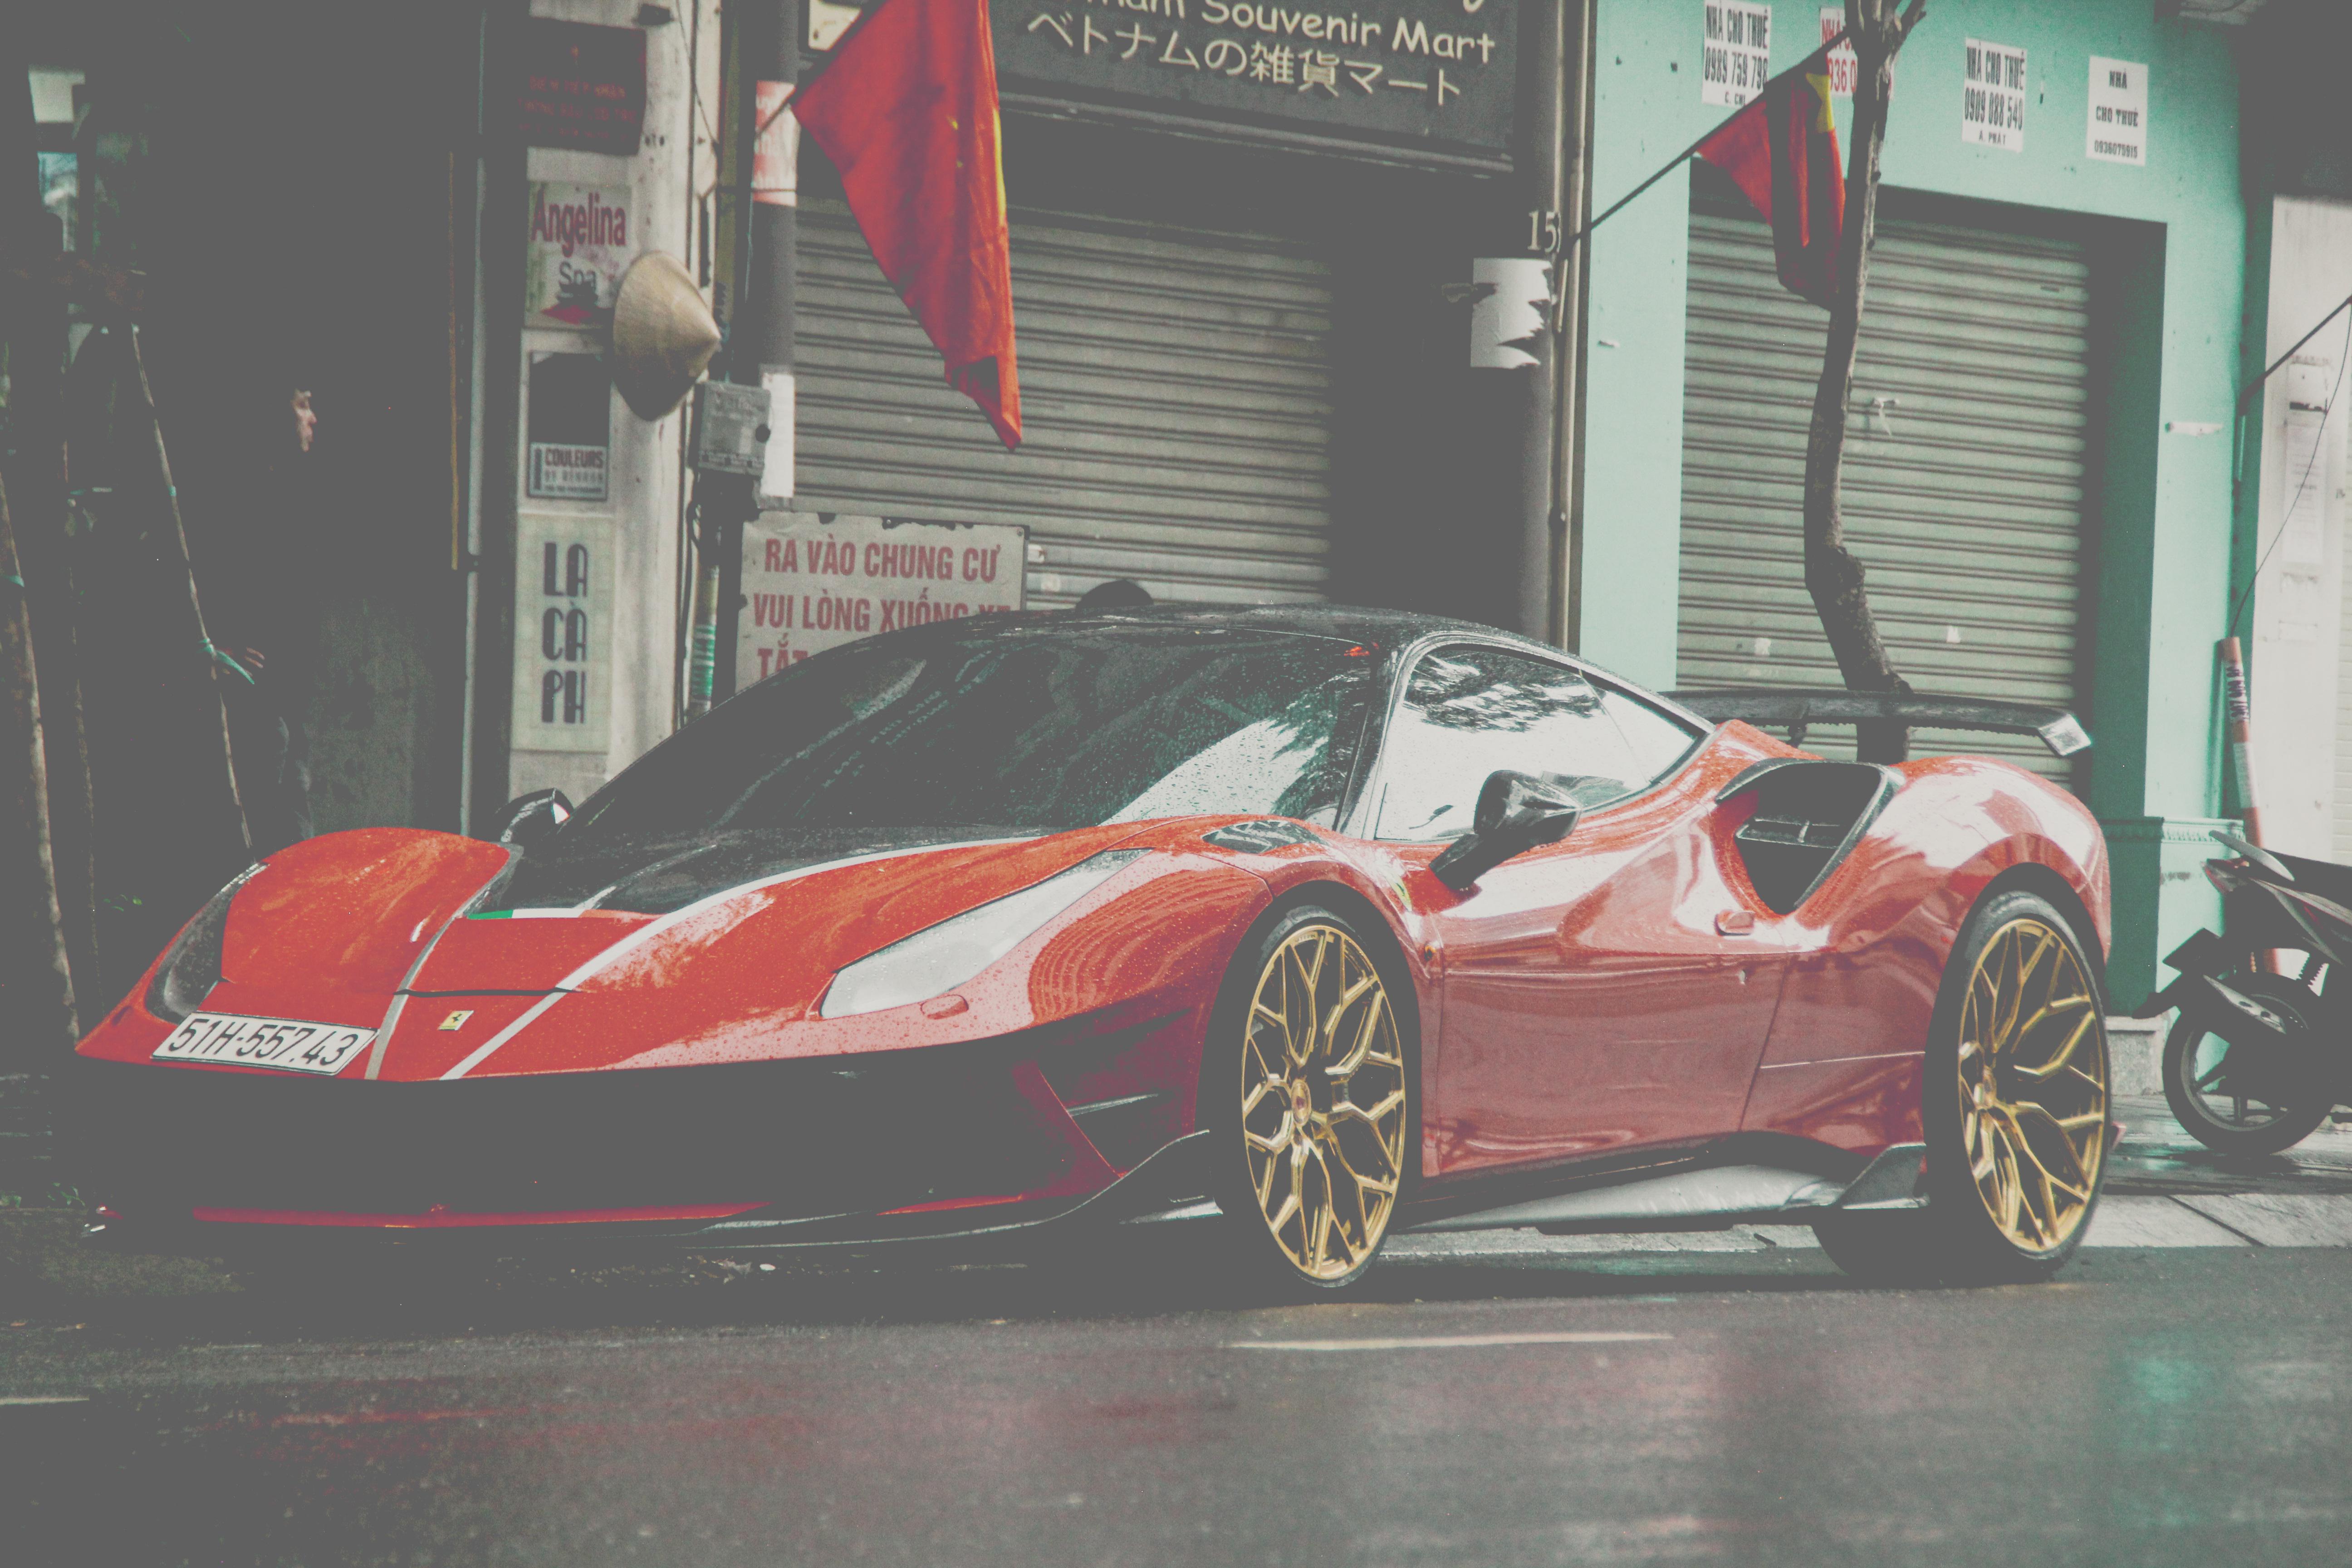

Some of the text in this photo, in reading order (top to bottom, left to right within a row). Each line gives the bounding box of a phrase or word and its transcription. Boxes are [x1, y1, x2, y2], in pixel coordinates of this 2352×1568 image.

[1201, 0, 1381, 46] Souvenir
[1392, 17, 1495, 64] Mart
[1727, 8, 1743, 44] CHO
[1027, 11, 1460, 106] ベトナムの雑貨マート
[1986, 50, 2001, 86] CHO
[2096, 106, 2112, 122] CHO
[530, 186, 627, 257] Angelina
[1528, 210, 1558, 253] 15
[544, 542, 588, 597] LA
[764, 533, 1002, 583] RA VÀO CHUNG CƯ
[542, 601, 587, 662] CÀ
[753, 593, 794, 628] VUI
[802, 588, 870, 632] LÒNG
[541, 669, 585, 724] PH
[167, 1018, 358, 1066] 51H-557.43
